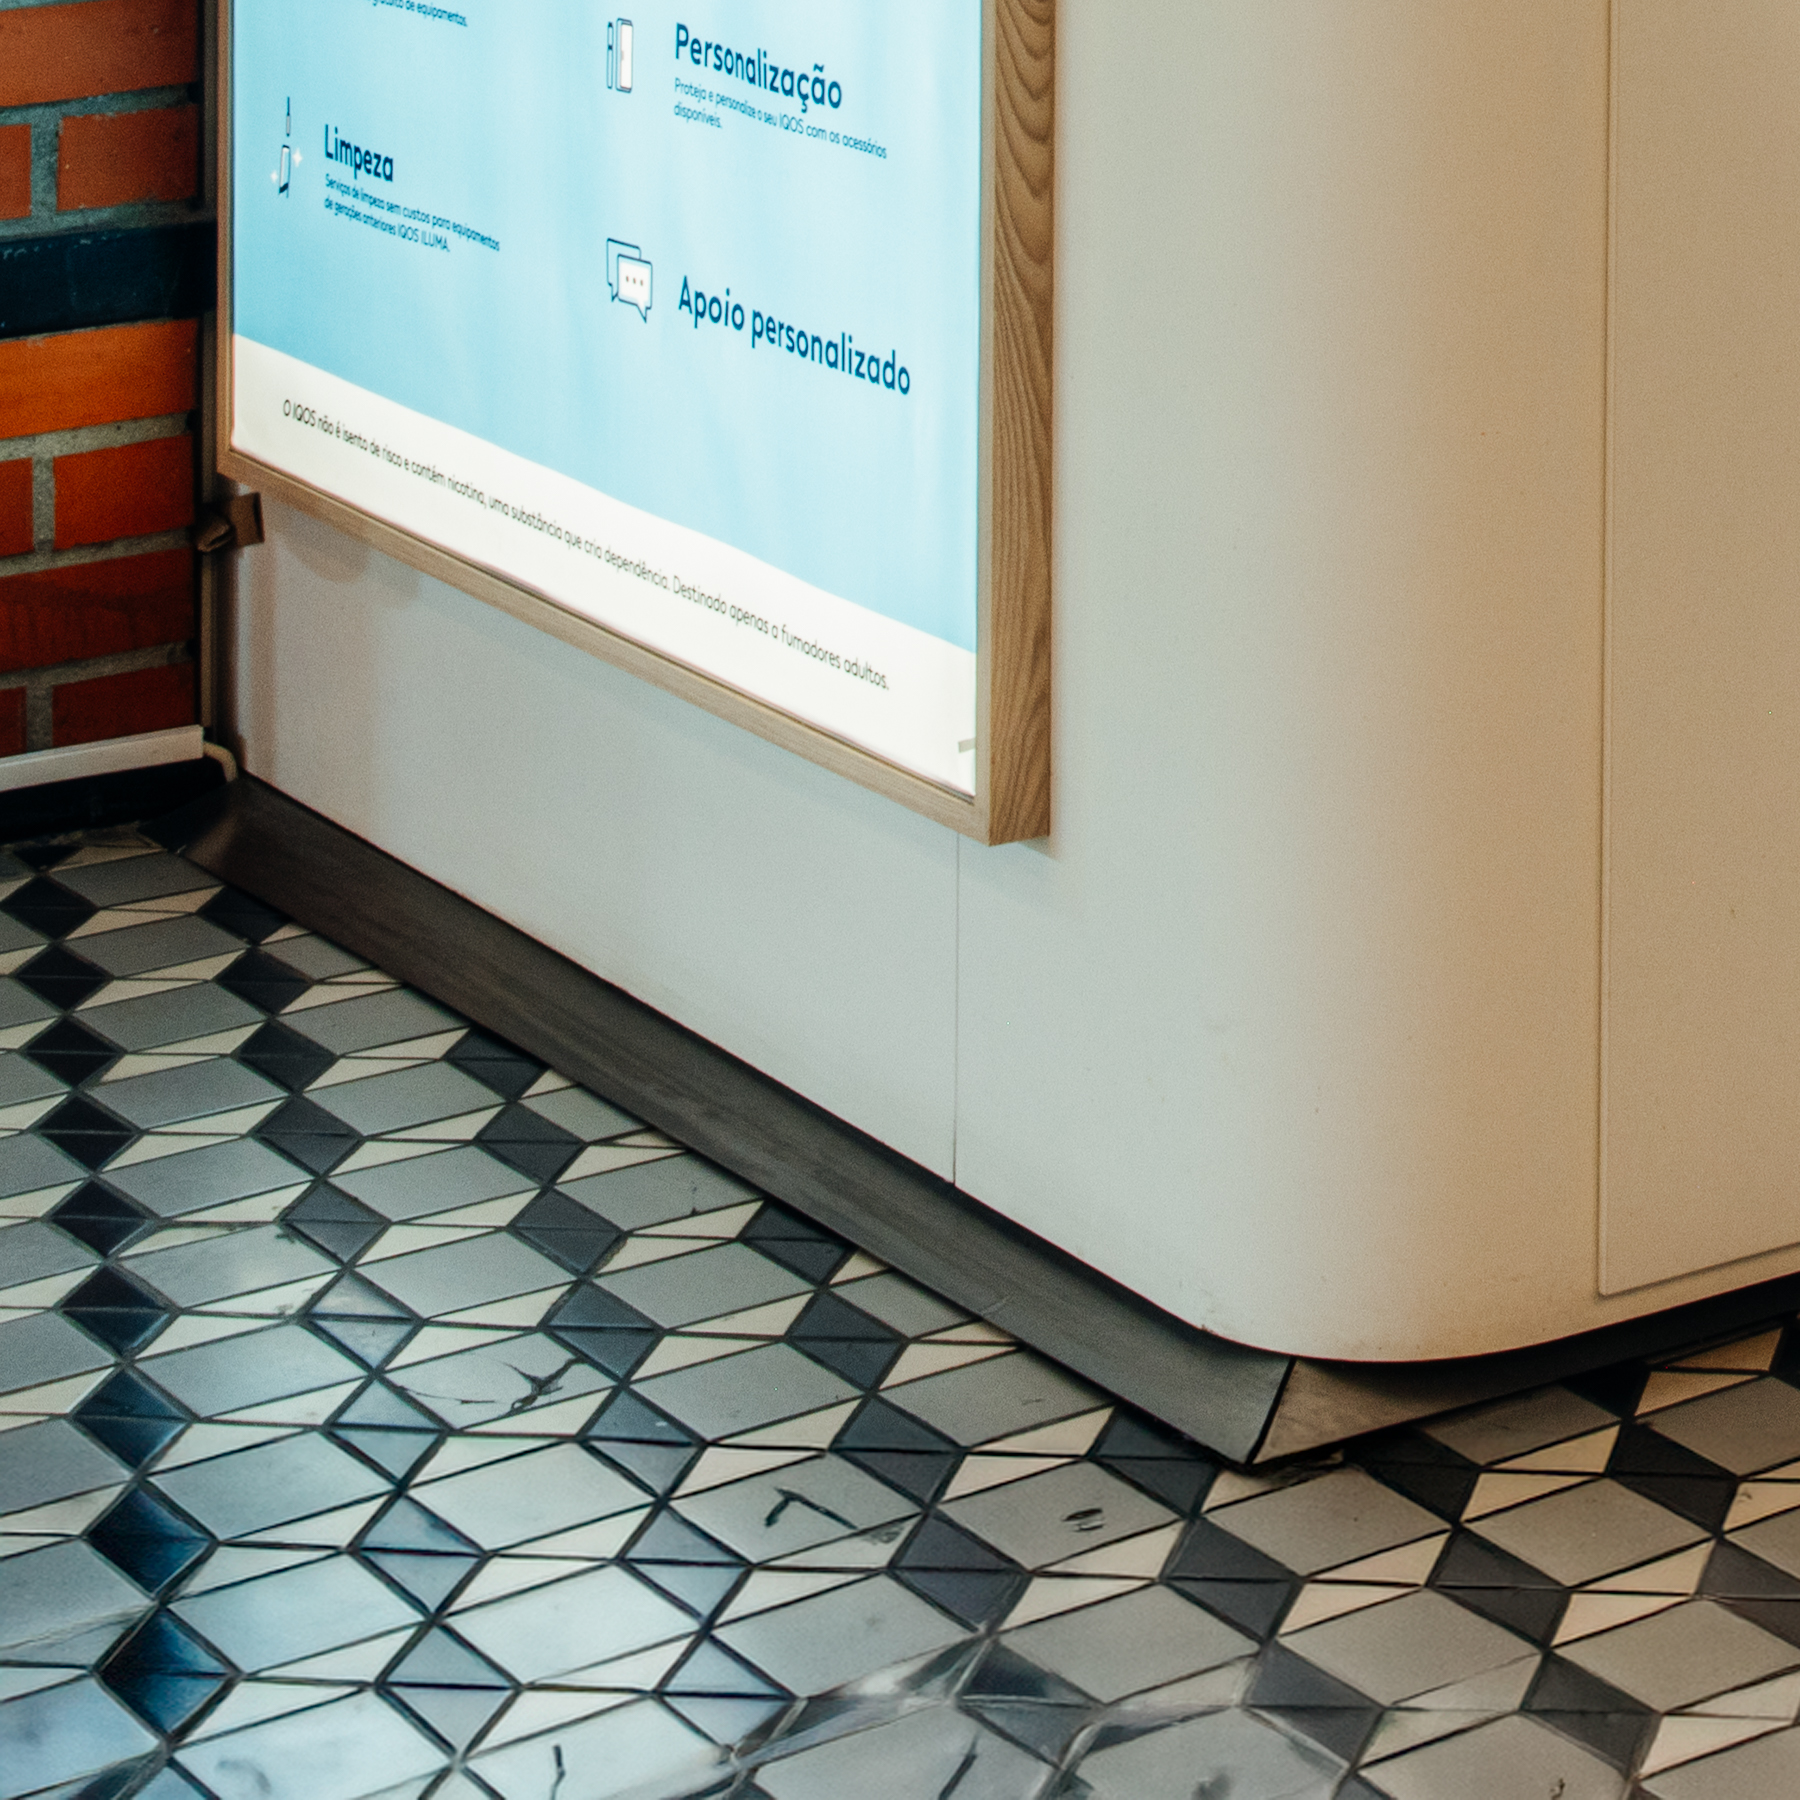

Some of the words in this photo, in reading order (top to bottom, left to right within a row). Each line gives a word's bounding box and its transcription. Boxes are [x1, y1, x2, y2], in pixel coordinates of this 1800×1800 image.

[676, 22, 842, 113] Personalização
[674, 101, 722, 129] disponíveis.
[675, 77, 707, 103] Proteja
[708, 90, 714, 102] e
[764, 112, 777, 126] seu
[779, 113, 804, 134] IQOS
[806, 123, 827, 141] com
[829, 130, 840, 144] os
[842, 133, 887, 159] acessórios
[325, 124, 393, 182] Limpeza
[398, 224, 419, 242] IQOS
[403, 206, 430, 224] custos
[432, 215, 451, 229] para
[679, 275, 744, 331] Apoio
[752, 309, 910, 395] personalizado
[283, 399, 291, 416] O
[293, 403, 316, 427] IQOS
[318, 415, 334, 435] não
[336, 420, 341, 438] é
[342, 423, 368, 451] isento
[370, 438, 380, 457] de
[382, 445, 402, 467] risco
[404, 458, 409, 470] e
[411, 464, 445, 486] contém
[448, 473, 487, 509] nicotina,
[489, 495, 509, 516] uma
[511, 505, 562, 540] substância
[565, 530, 582, 549] que
[584, 538, 602, 559] cria
[604, 544, 670, 590] dependência.
[673, 574, 727, 614] Destinado
[730, 604, 769, 634] apenas
[772, 625, 778, 638] a
[781, 623, 840, 670] fumadores
[844, 656, 889, 690] adultos.
